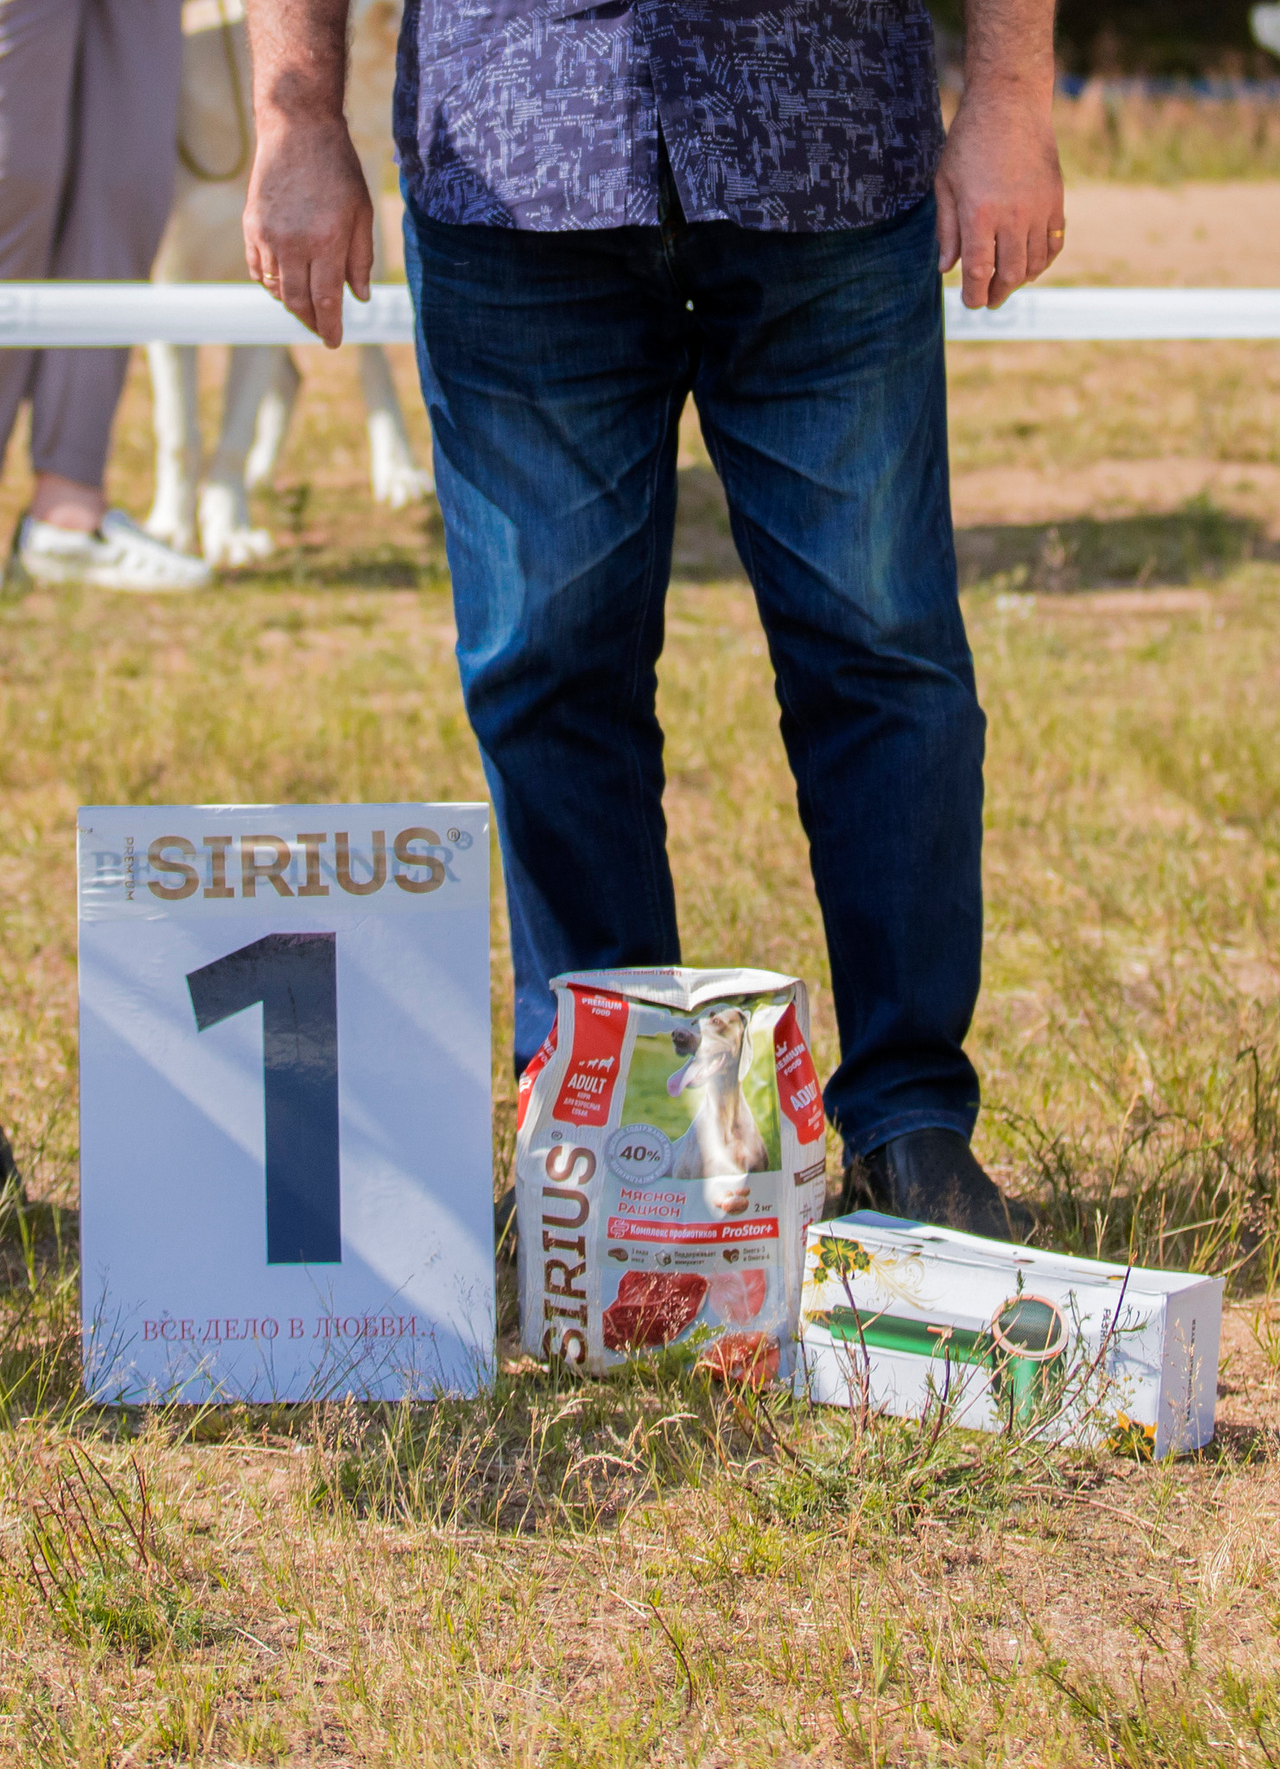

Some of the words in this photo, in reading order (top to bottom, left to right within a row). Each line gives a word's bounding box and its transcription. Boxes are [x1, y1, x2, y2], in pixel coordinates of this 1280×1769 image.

[147, 826, 446, 901] SIRIUS
[581, 997, 622, 1010] PREMIUM
[591, 1007, 611, 1017] FOOD
[567, 1073, 607, 1094] ADULT
[185, 932, 342, 1265] 1
[619, 1145, 661, 1162] 40%
[620, 1187, 687, 1205] МЯСНОЙ
[617, 1202, 681, 1217] РАЦИОН
[754, 1204, 760, 1212] 2
[630, 1223, 668, 1238] Комплекс
[669, 1228, 718, 1240] пробиотиков
[721, 1222, 773, 1239] ProStor+
[542, 1145, 597, 1365] SIRIUS
[142, 1319, 196, 1342] ВСЕ
[202, 1317, 280, 1345] ДЕЛО
[288, 1318, 305, 1340] В
